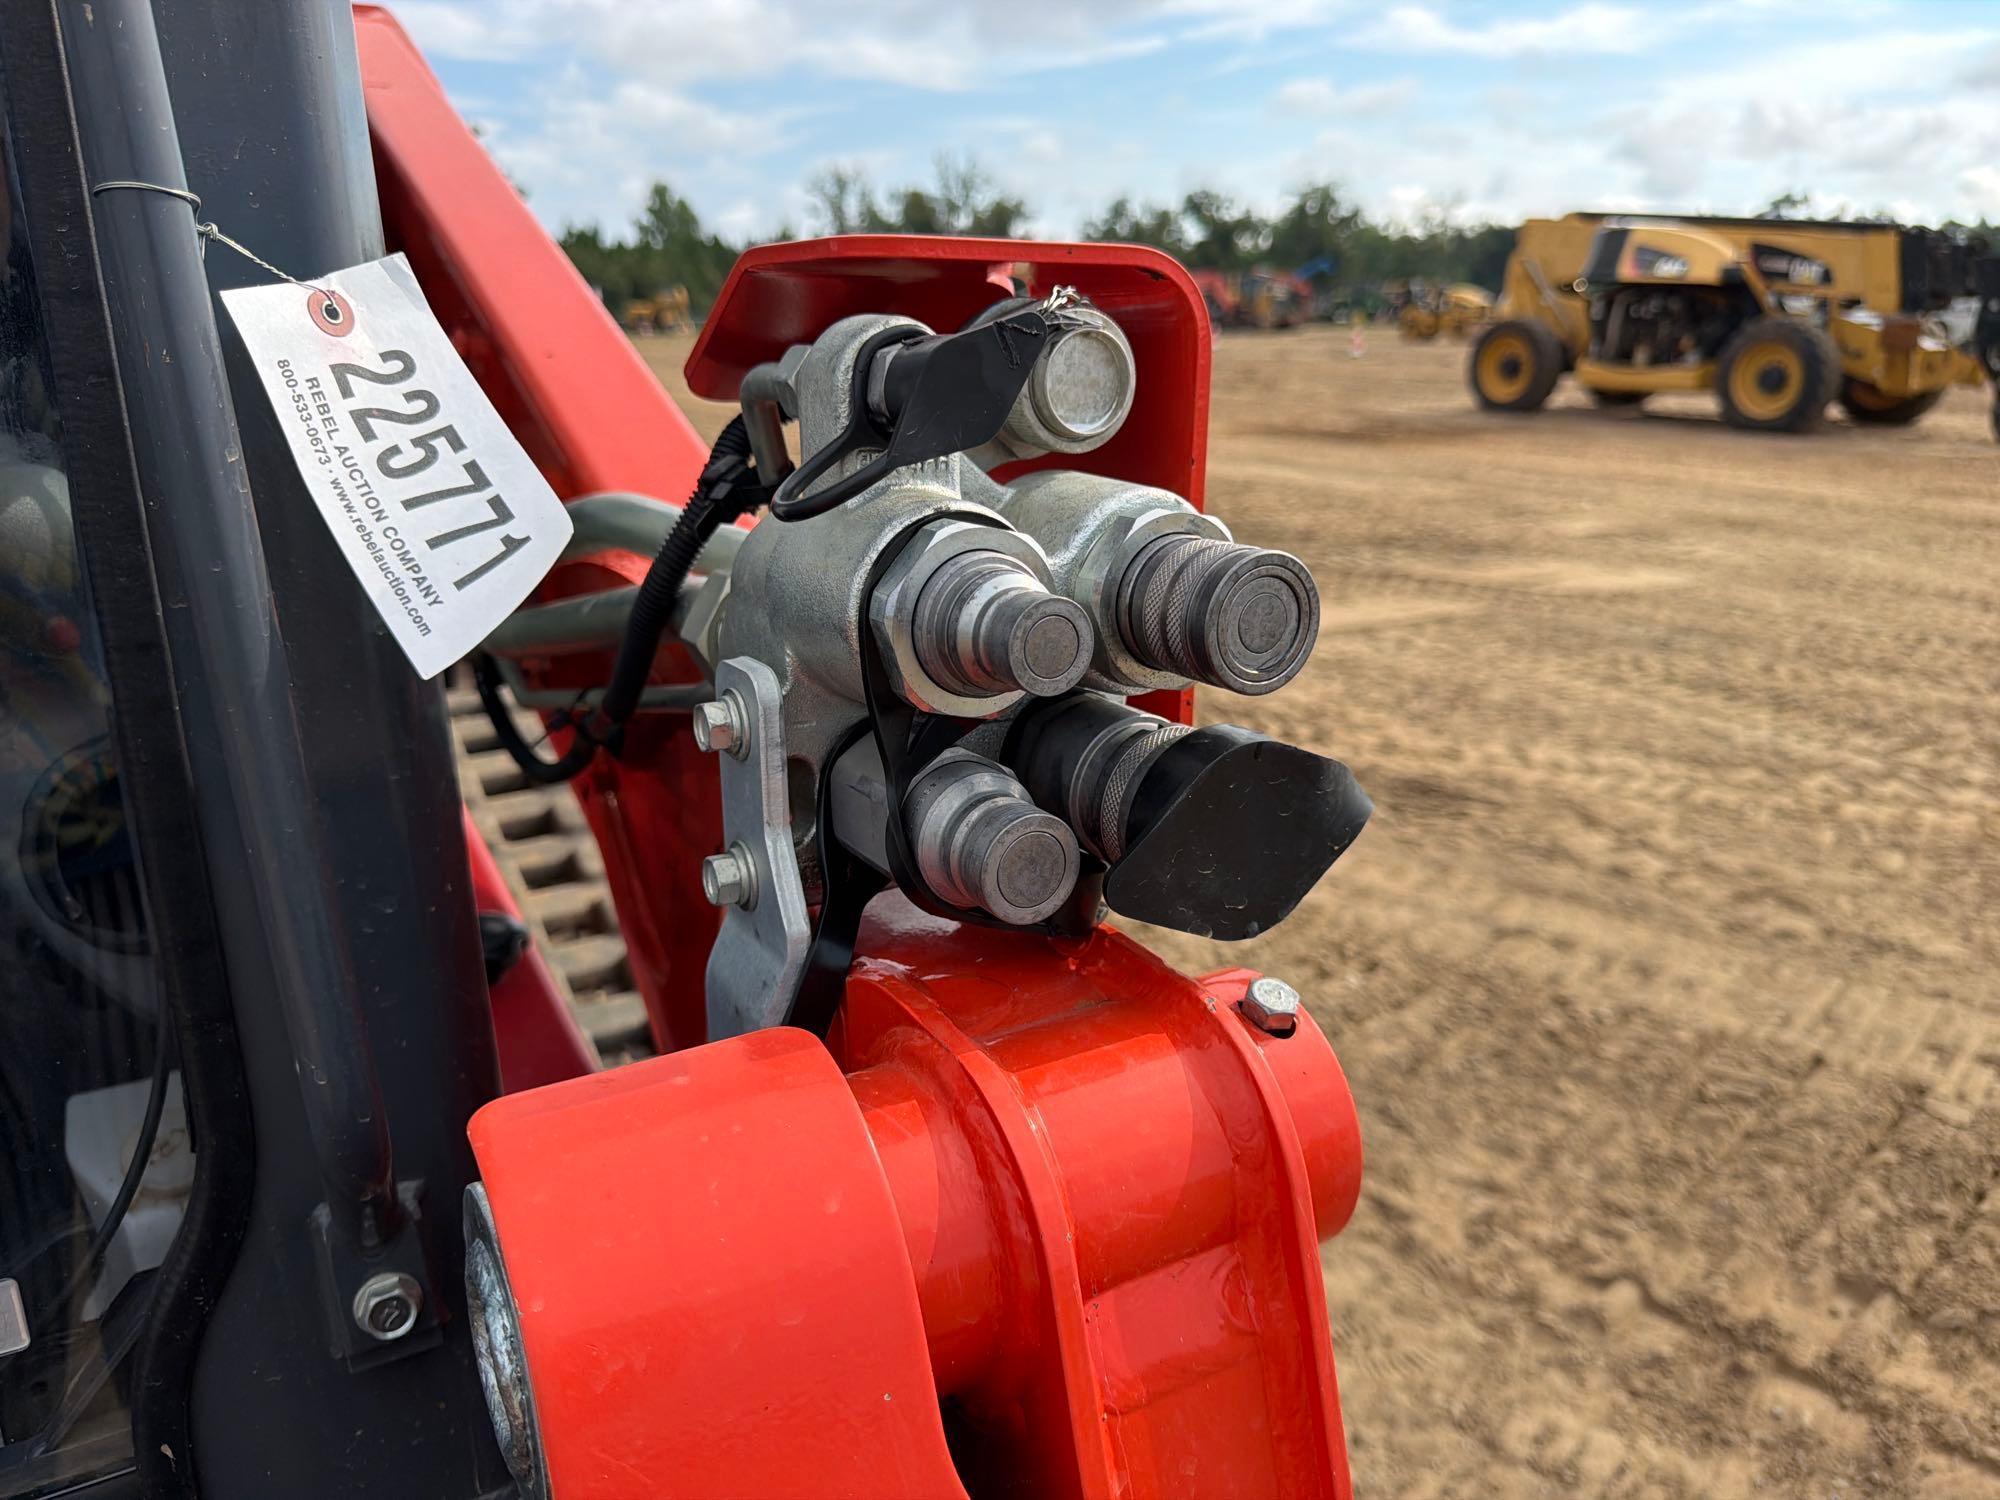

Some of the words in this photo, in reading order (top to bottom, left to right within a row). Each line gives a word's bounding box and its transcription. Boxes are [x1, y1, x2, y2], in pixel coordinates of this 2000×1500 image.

[277, 359, 332, 466] 800-533-0673
[329, 477, 432, 637] www.rebelauction.com
[305, 376, 340, 441] REBEL
[334, 445, 389, 523] AUCTION
[382, 526, 444, 608] COMPANY
[329, 350, 531, 591] 225771
